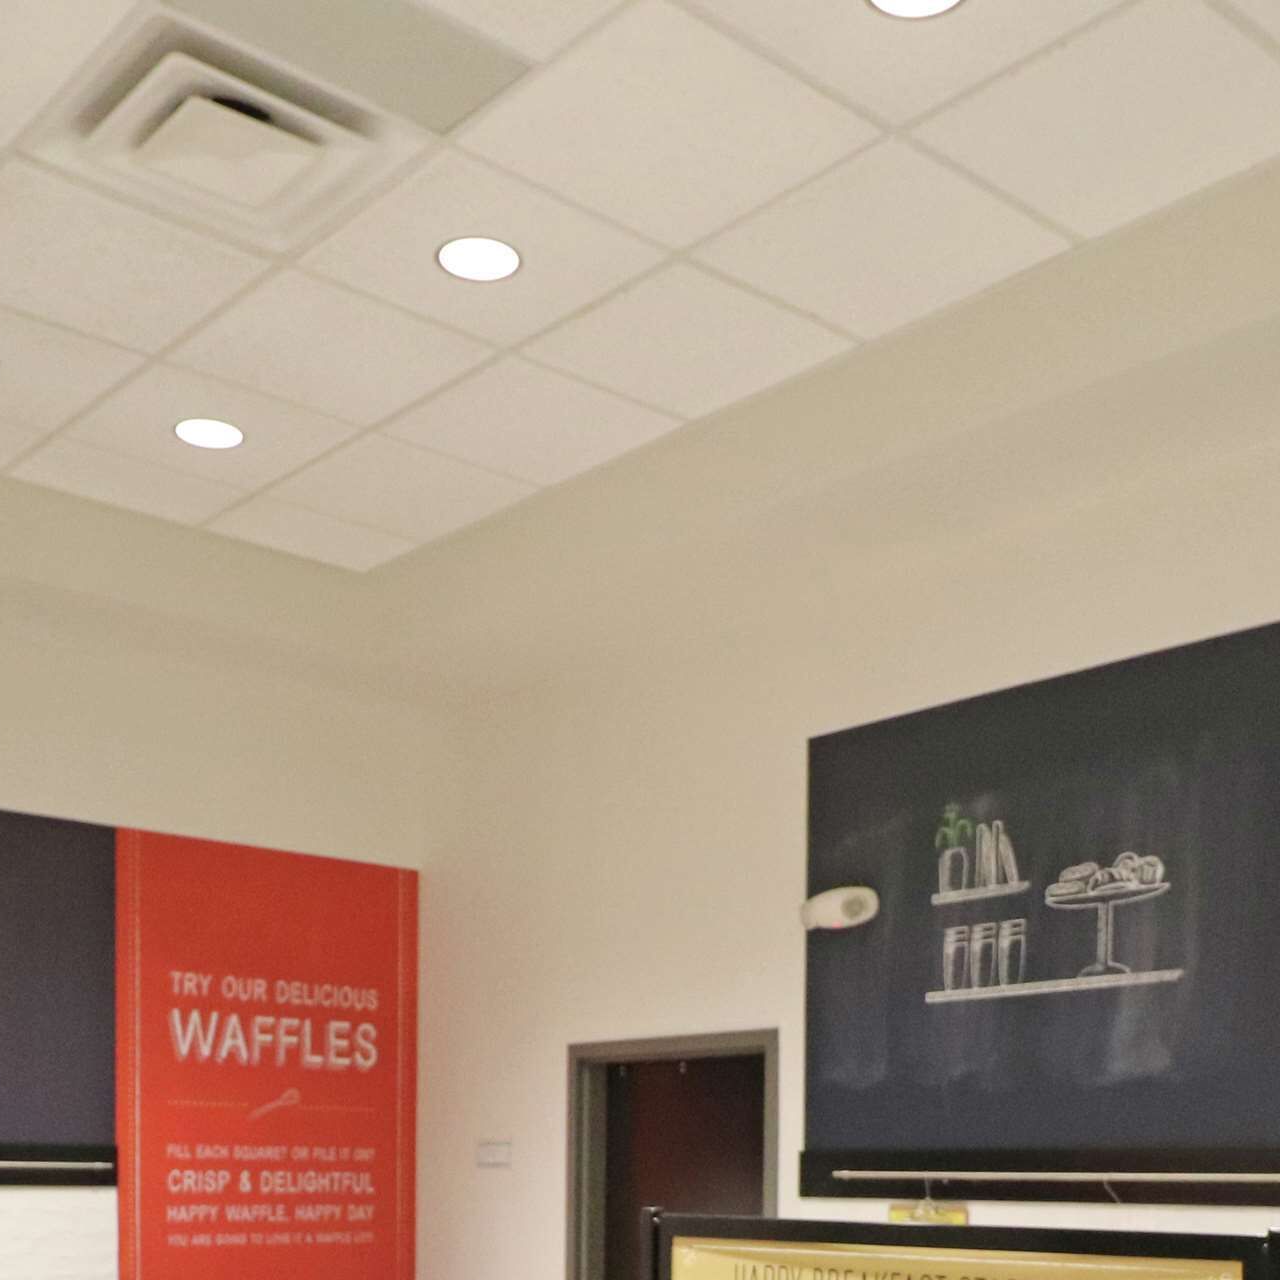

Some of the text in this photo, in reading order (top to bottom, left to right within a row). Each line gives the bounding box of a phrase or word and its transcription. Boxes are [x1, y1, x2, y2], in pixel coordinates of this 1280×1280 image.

[170, 971, 379, 1011] TRY OUR DELICIOUS
[170, 1007, 379, 1070] WAFFLES
[167, 1168, 375, 1194] CRISP & DELIGHTFUL
[167, 1204, 218, 1222] HAPPY
[294, 1204, 341, 1221] HAPPY
[348, 1204, 375, 1221] DAY
